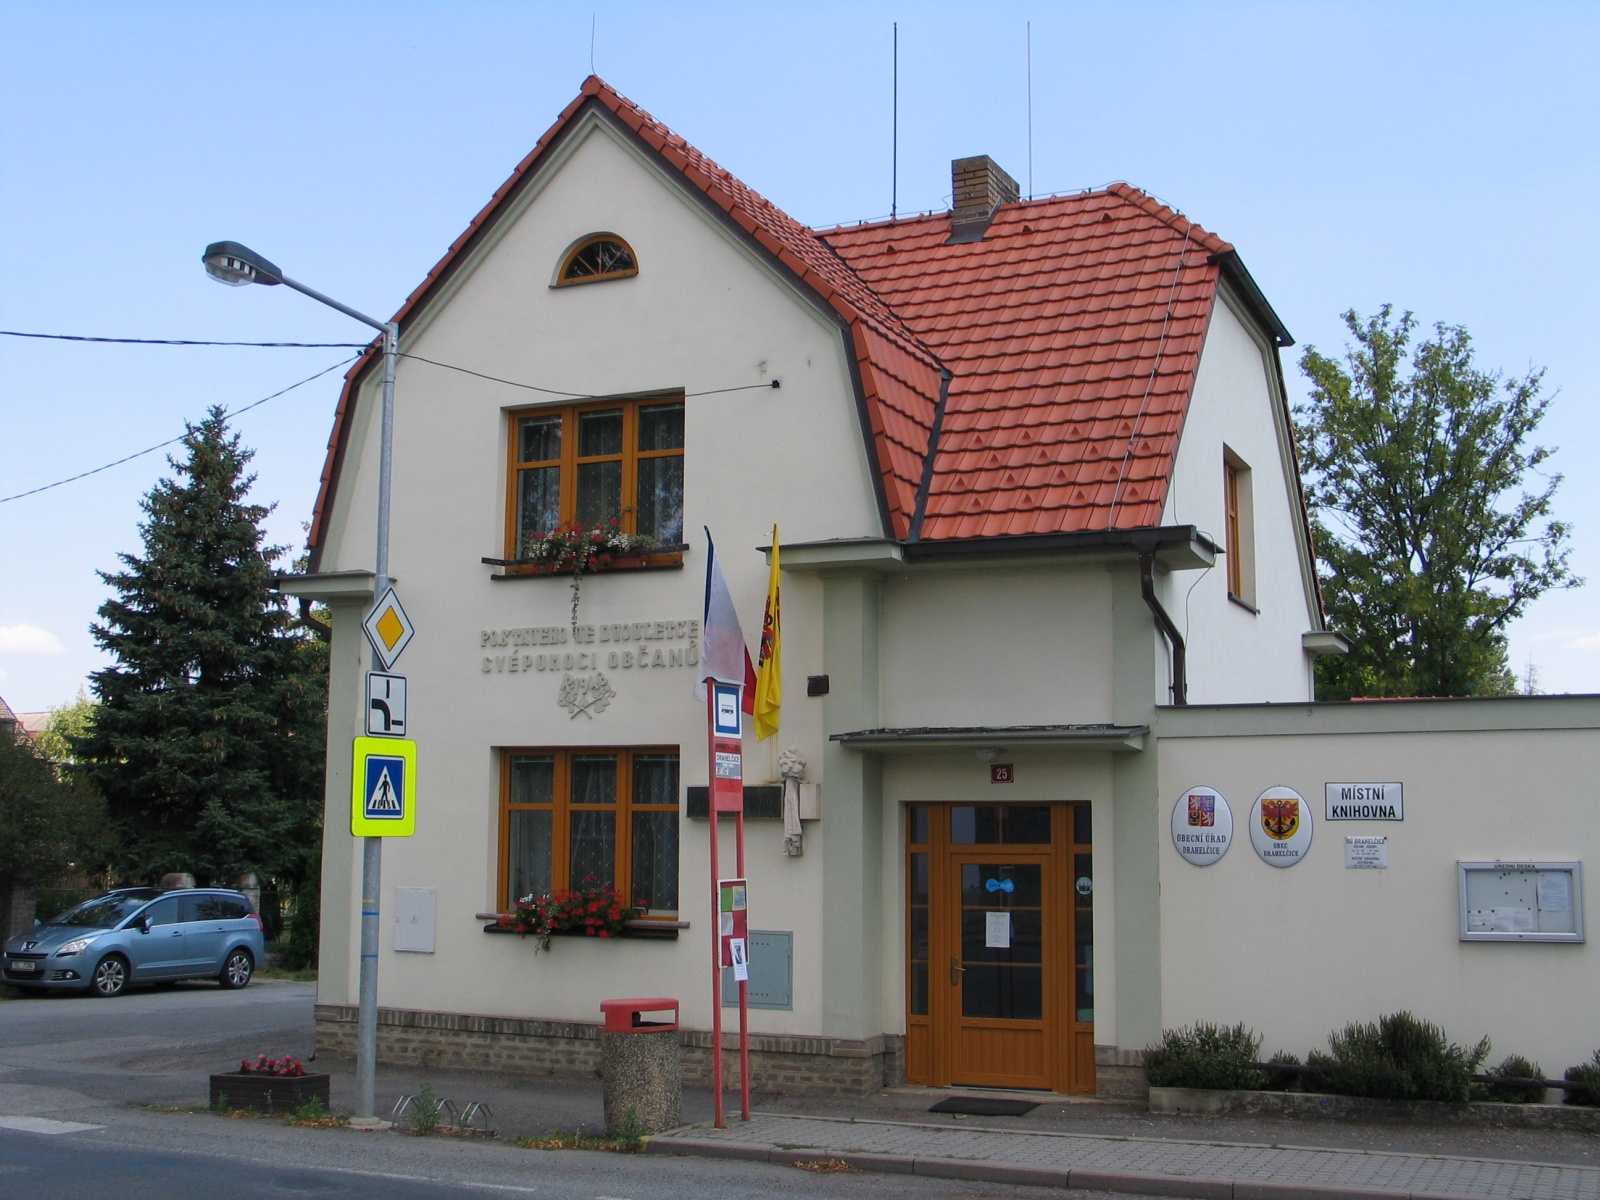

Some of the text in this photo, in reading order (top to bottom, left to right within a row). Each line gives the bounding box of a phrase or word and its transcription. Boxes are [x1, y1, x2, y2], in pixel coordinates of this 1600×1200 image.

[607, 640, 699, 668] OBČANŮ
[716, 753, 740, 763] DRAHELČICE
[996, 768, 1008, 780] 25
[1341, 785, 1386, 801] MÍSTNÍ
[1331, 804, 1396, 819] KNIHOVNA
[1176, 832, 1227, 843] OBECNÍ ÚŘAD
[1182, 844, 1221, 855] DRAHELČICE
[1273, 842, 1288, 850] OBEC
[1263, 849, 1299, 858] DRAHELČICE
